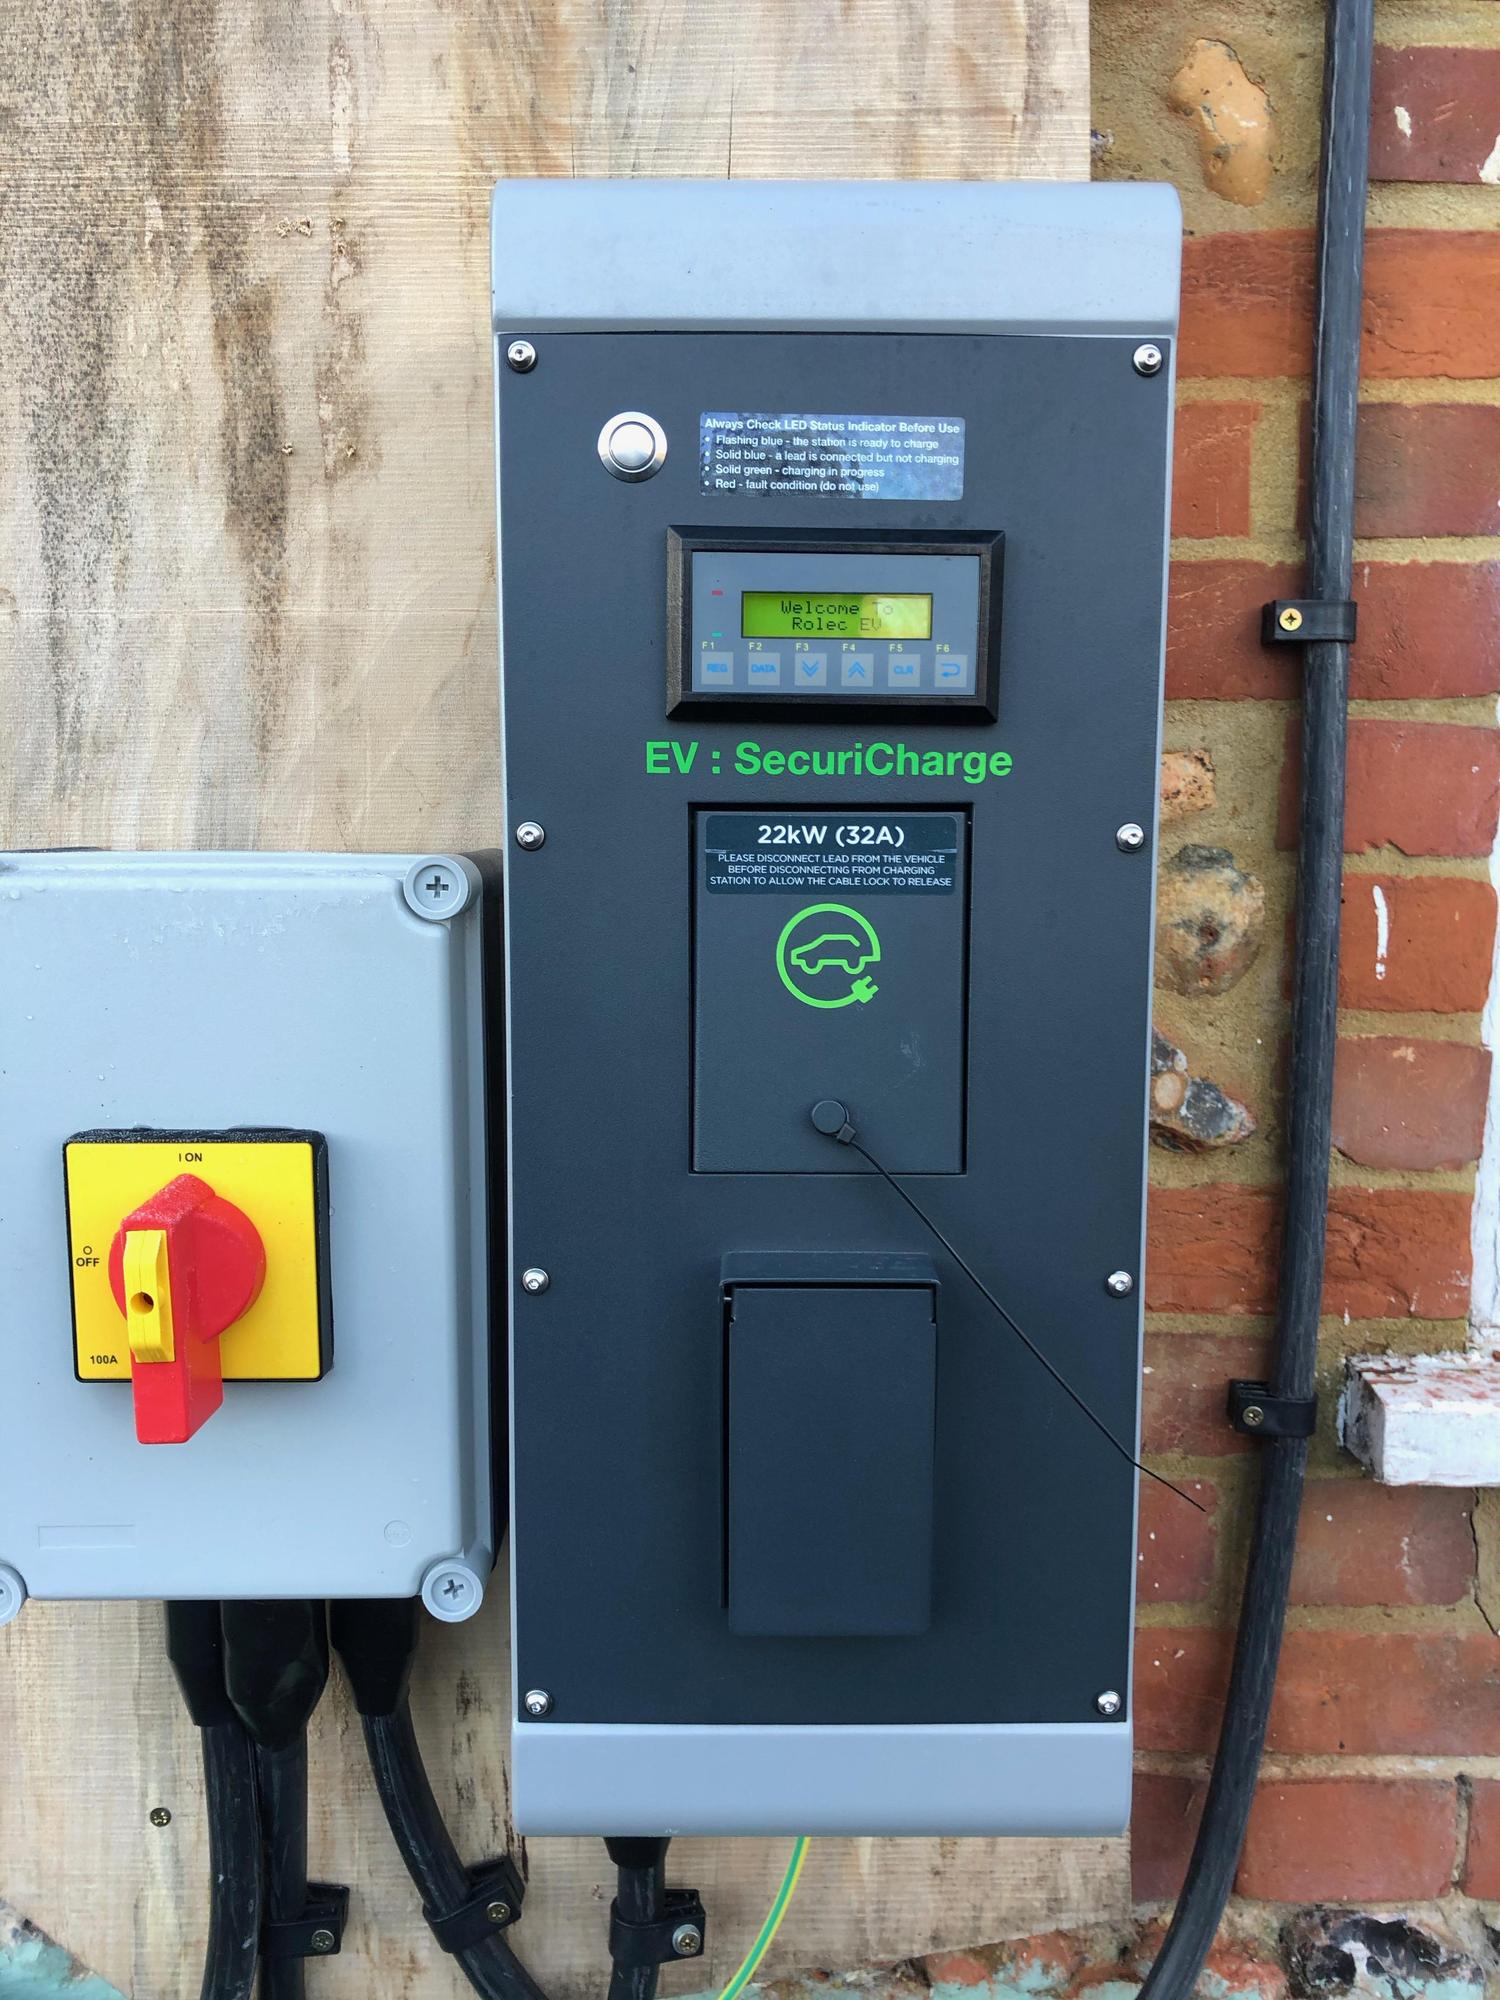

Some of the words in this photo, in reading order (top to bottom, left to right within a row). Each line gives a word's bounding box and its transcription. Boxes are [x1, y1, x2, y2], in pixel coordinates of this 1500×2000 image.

[705, 419, 744, 430] Always
[747, 419, 782, 430] Check
[785, 420, 807, 430] LED
[810, 420, 845, 431] Status
[848, 421, 896, 432] Indicator
[899, 422, 935, 433] Before
[938, 423, 960, 434] Use
[716, 435, 758, 446] Flashing
[761, 436, 783, 446] blue
[793, 437, 809, 446] the
[811, 437, 846, 447] station
[849, 438, 857, 448] is
[860, 438, 888, 449] ready
[890, 439, 901, 448] to
[904, 439, 938, 450] charge
[716, 450, 742, 460] Solid
[744, 451, 766, 460] blue
[775, 452, 782, 460] a
[784, 451, 806, 461] lead
[809, 452, 817, 461] is
[820, 452, 873, 462] connected
[876, 454, 893, 463] but
[895, 454, 912, 463] not
[914, 454, 959, 465] charging
[715, 465, 741, 475] Solid
[744, 466, 772, 477] green
[782, 466, 826, 477] charging
[829, 467, 838, 476] in
[841, 468, 885, 479] progress
[715, 479, 736, 488] Red
[746, 480, 768, 489] fault
[770, 481, 817, 490] condition
[820, 481, 836, 492] (do
[838, 482, 856, 491] not
[858, 482, 879, 493] use)
[781, 601, 859, 614] Welcome
[872, 602, 894, 616] To
[792, 617, 848, 631] Rolec
[860, 618, 882, 631] EV
[707, 664, 727, 672] REG
[751, 664, 776, 673] DATA
[894, 665, 914, 674] CLR
[646, 741, 698, 773] EV
[734, 741, 1013, 784] SecuriCharge
[758, 825, 828, 845] 22kW
[835, 825, 904, 848] (32A)
[718, 854, 755, 863] PLEASE
[758, 854, 820, 863] DISCONNECT
[823, 855, 849, 863] LEAD
[852, 855, 880, 864] FROM
[883, 856, 902, 864] THE
[904, 855, 945, 864] VEHICLE
[728, 865, 767, 874] BEFORE
[769, 866, 849, 874] DISCONNECTING
[852, 866, 881, 875] FROM
[883, 866, 935, 875] CHARGING
[710, 877, 751, 885] STATION
[753, 877, 767, 885] TO
[769, 877, 805, 886] ALLOW
[807, 877, 826, 886] THE
[828, 877, 861, 886] CABLE
[864, 877, 890, 886] LOCK
[891, 878, 905, 886] TO
[908, 878, 952, 887] RELEASE
[185, 1153, 202, 1162] ON
[76, 1257, 99, 1267] OFF
[90, 1355, 118, 1365] 100A
